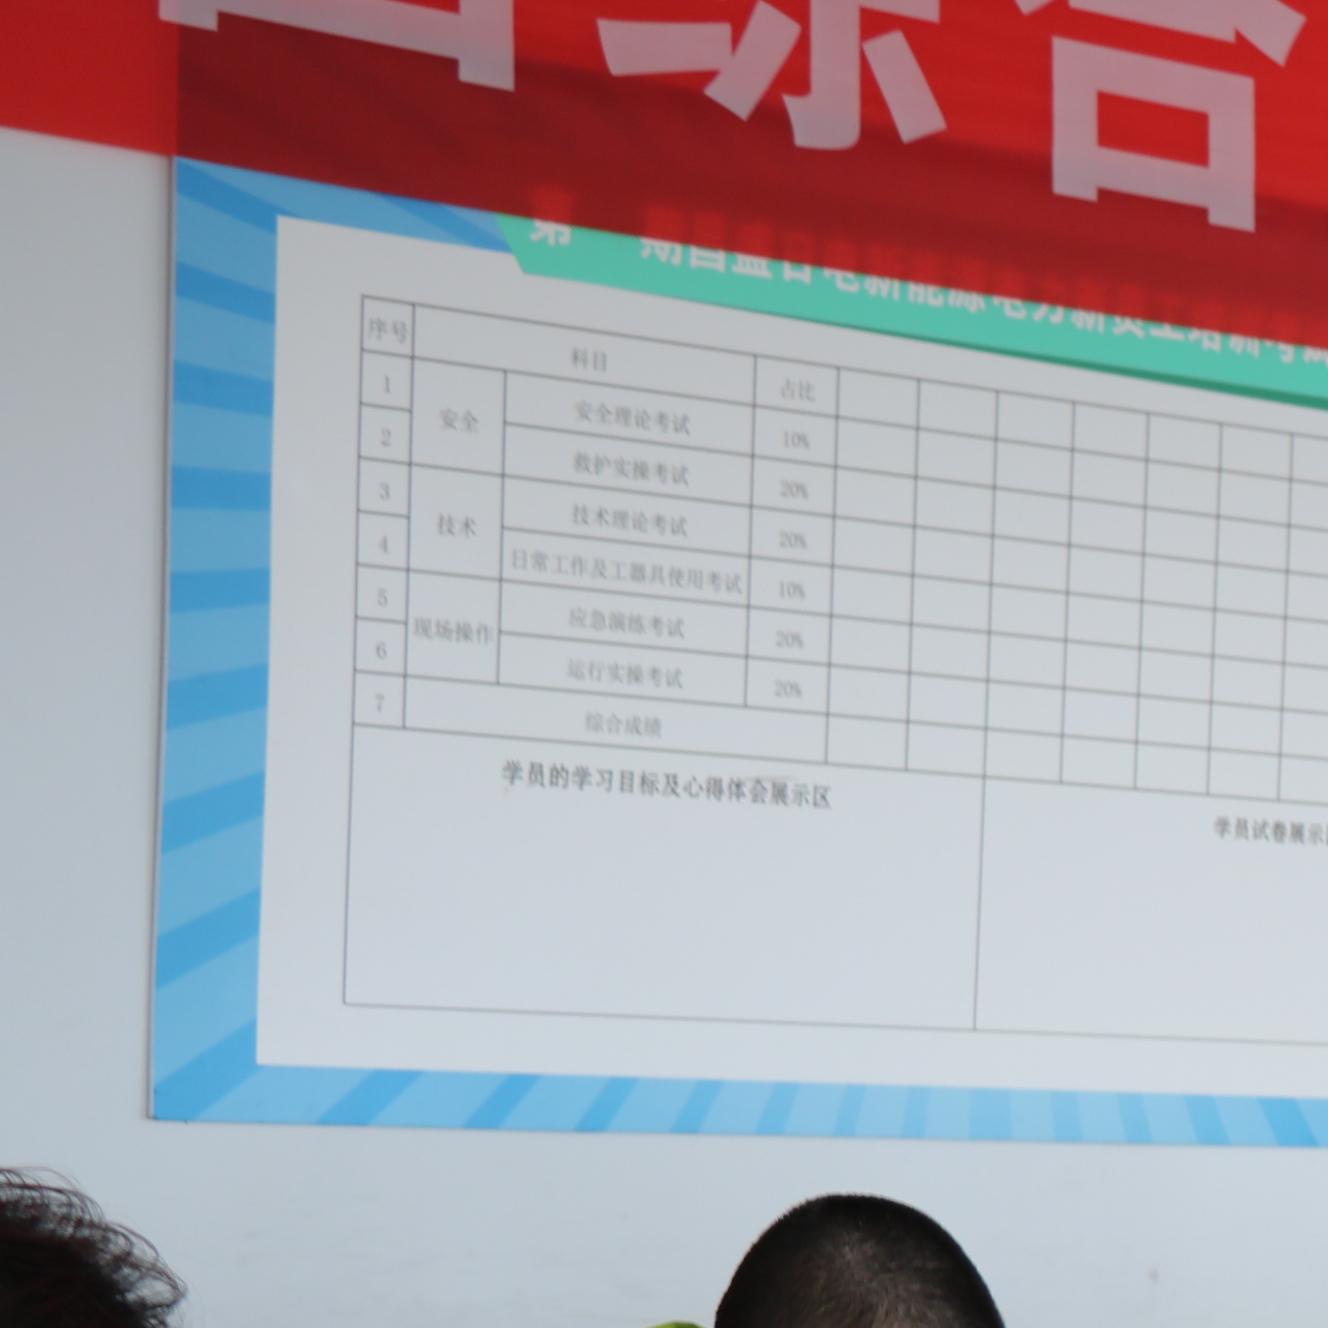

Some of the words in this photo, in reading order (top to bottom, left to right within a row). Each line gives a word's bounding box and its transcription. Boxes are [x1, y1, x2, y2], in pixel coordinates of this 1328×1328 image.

[368, 318, 409, 345] 序号
[571, 347, 608, 373] 科目
[780, 378, 816, 402] 占比
[439, 407, 479, 435] 安全
[575, 400, 691, 436] 安全理论考试
[782, 430, 811, 451] 10%
[380, 429, 391, 448] 2
[780, 480, 810, 501] 20%
[379, 482, 390, 501] 3
[437, 512, 477, 538] 技术
[571, 504, 688, 538] 技术理论考试
[779, 530, 808, 551] 20%
[377, 535, 389, 555] 4
[778, 579, 807, 601] 10%
[377, 588, 388, 608] 5
[413, 617, 495, 646] 现场操作
[568, 607, 686, 640] 应急演练考试
[776, 630, 805, 651] 20%
[376, 641, 388, 660] 6
[566, 657, 684, 689] 运行实操考试
[774, 679, 804, 700] 20%
[375, 694, 386, 714] 7
[584, 711, 663, 738] 综合成绩
[503, 758, 833, 810] 学员的学习目标及心得体会展示区
